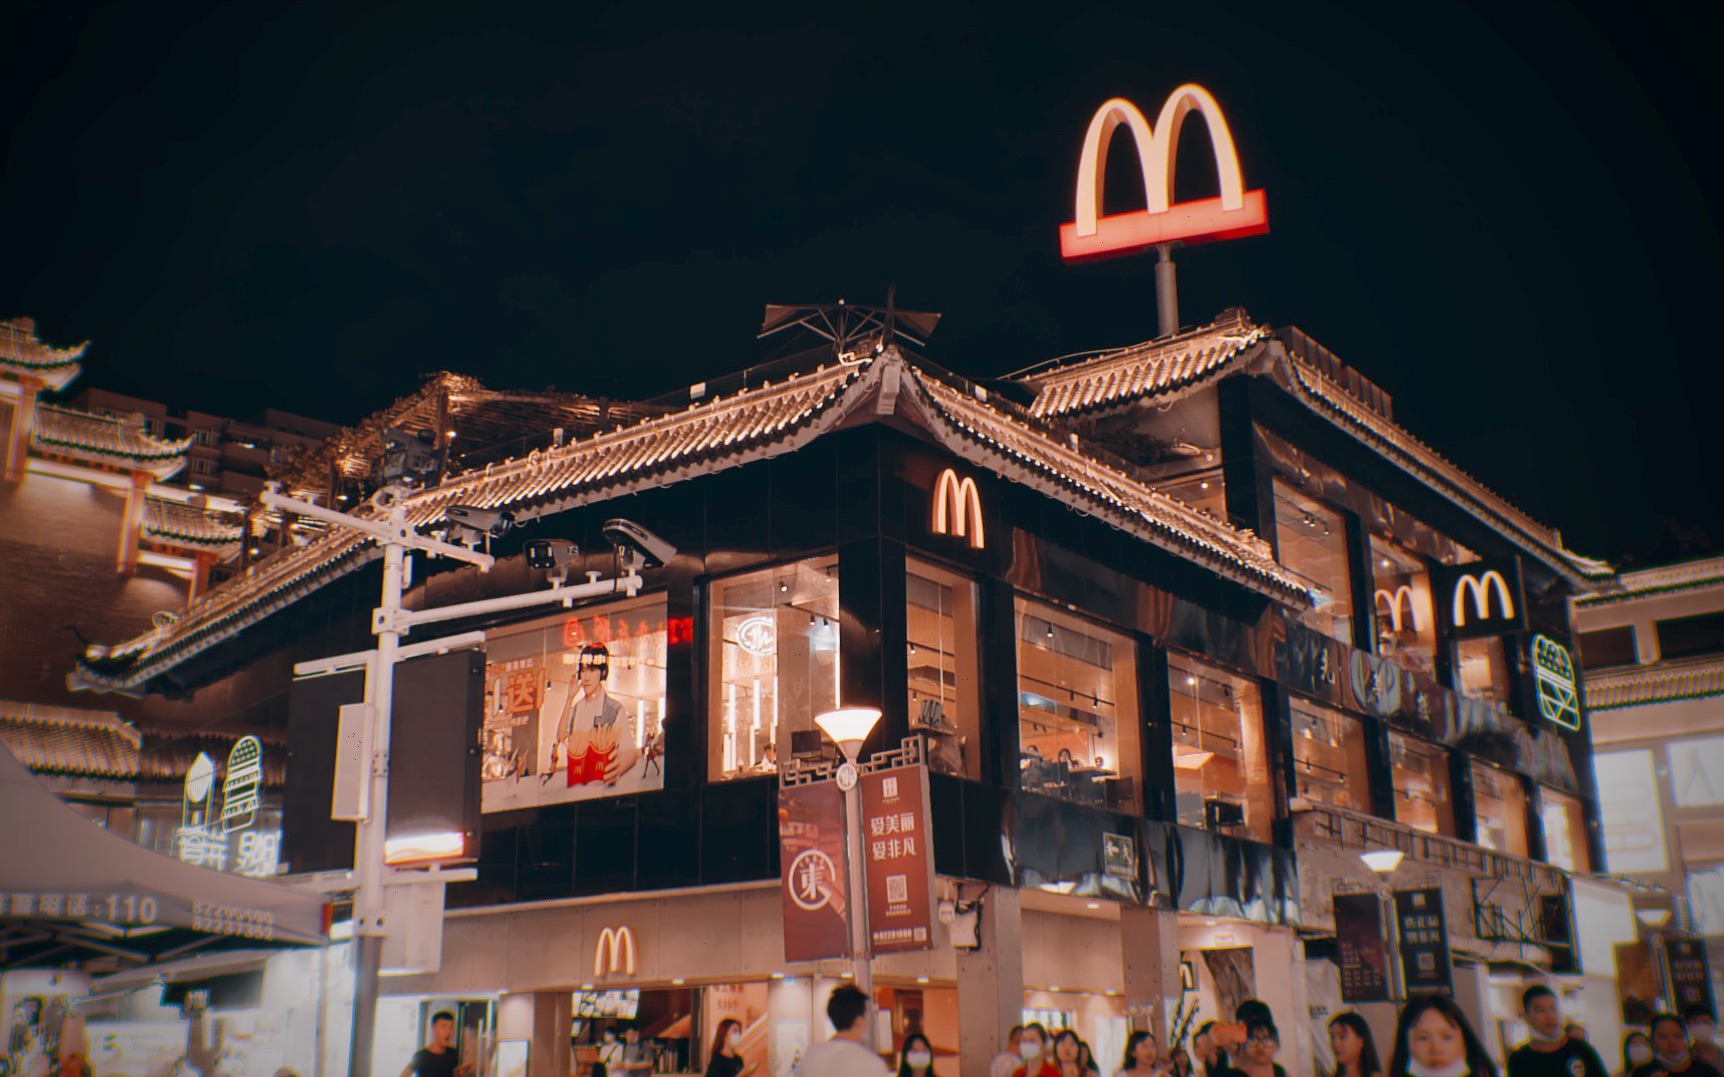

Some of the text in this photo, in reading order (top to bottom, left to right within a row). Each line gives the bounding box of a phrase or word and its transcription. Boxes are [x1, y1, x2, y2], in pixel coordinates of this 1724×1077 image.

[871, 812, 915, 836] 爱美丽
[873, 836, 917, 861] 爱非凡
